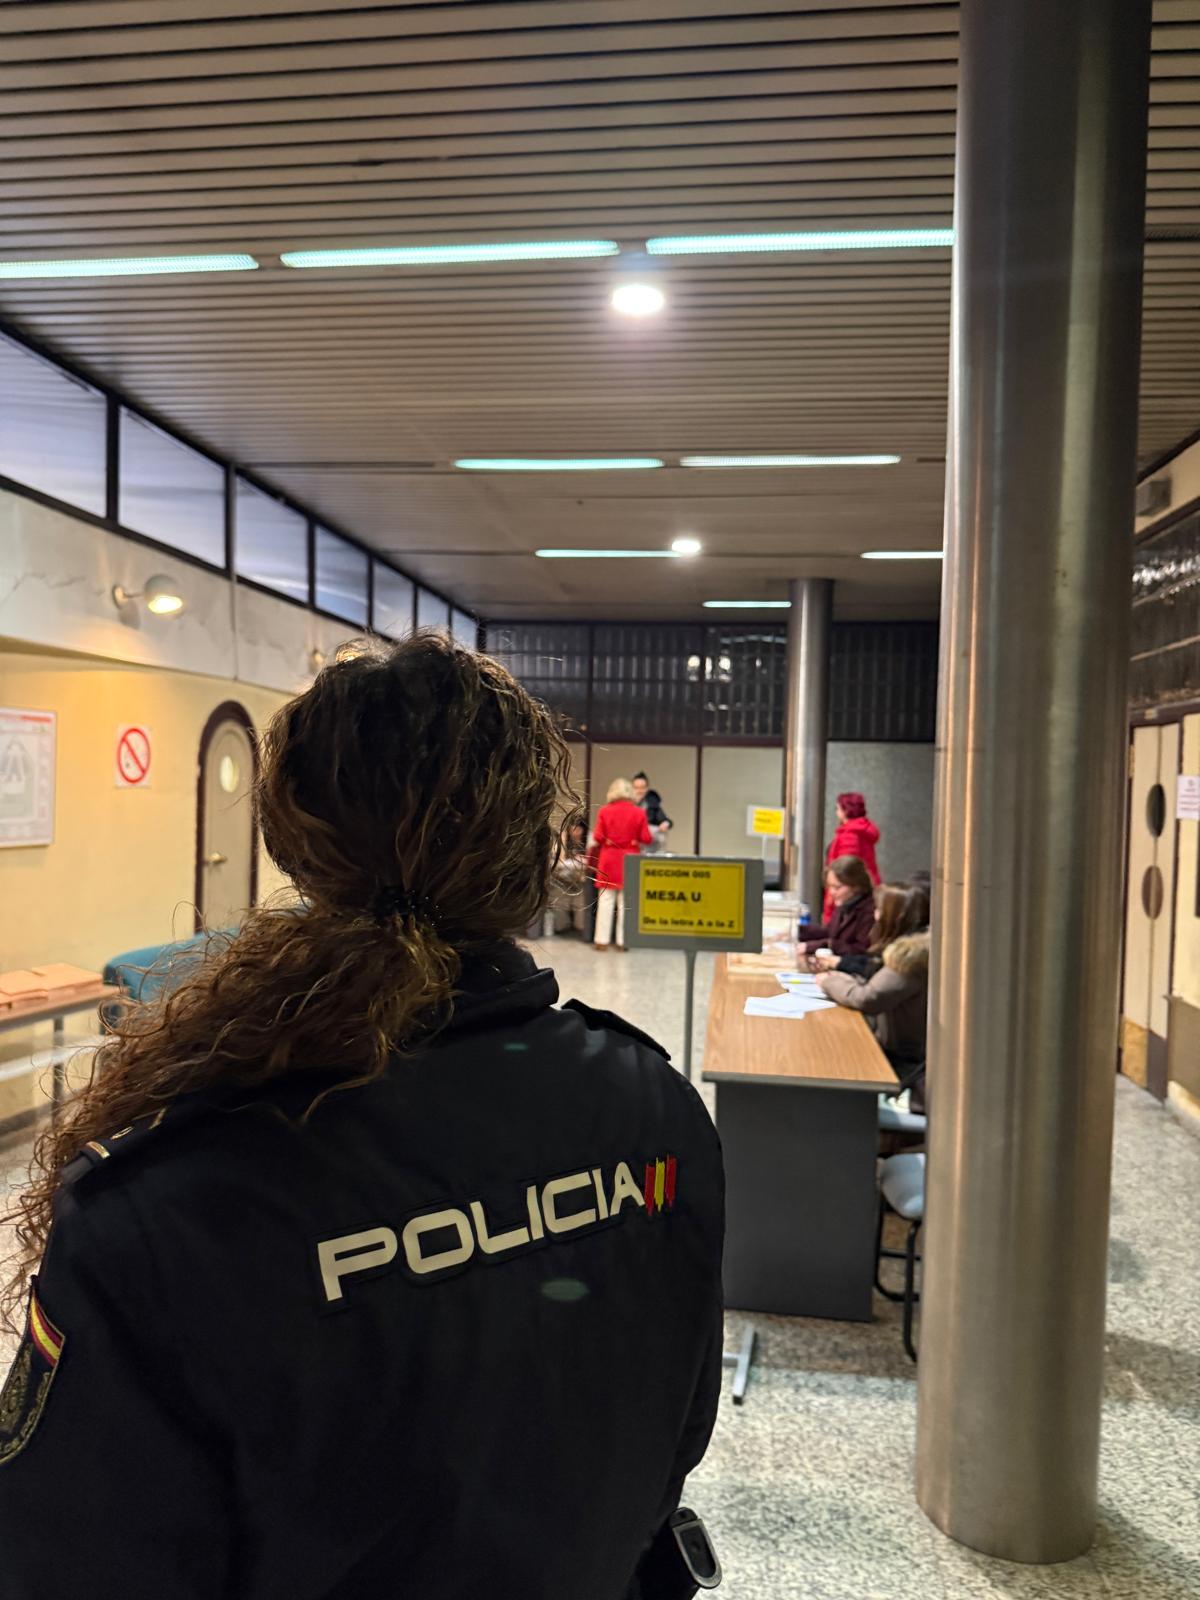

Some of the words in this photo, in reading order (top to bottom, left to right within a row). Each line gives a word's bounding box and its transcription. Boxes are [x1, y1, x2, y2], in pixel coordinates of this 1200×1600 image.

[646, 890, 687, 902] MESA
[691, 892, 702, 902] U
[643, 916, 656, 925] De
[659, 917, 669, 926] la
[671, 918, 694, 926] letra
[697, 919, 704, 927] A
[716, 919, 725, 927] la
[728, 920, 735, 928] Z
[318, 1162, 645, 1300] POLICIA
